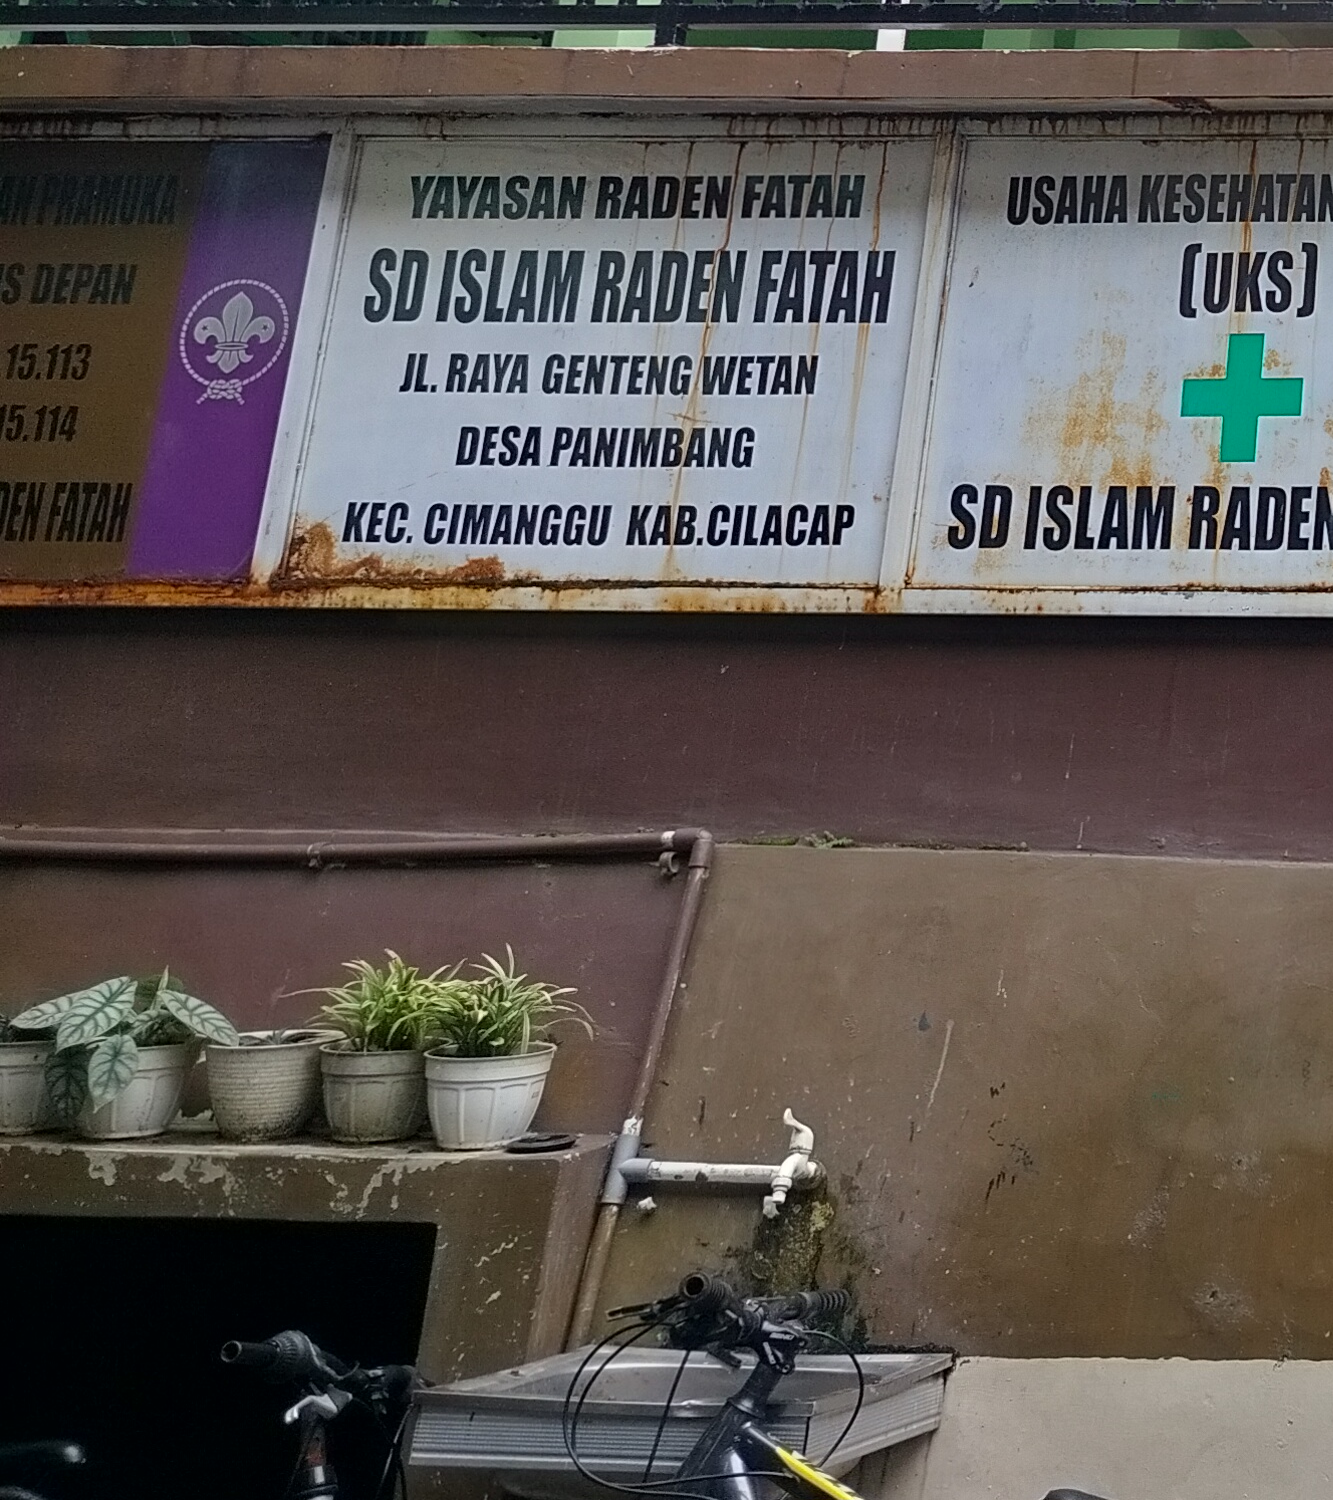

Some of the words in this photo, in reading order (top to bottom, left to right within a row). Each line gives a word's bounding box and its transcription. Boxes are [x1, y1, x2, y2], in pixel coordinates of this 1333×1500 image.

[410, 175, 586, 219] YAYASAN
[595, 176, 730, 219] RADEN
[742, 175, 865, 218] FATAH
[1006, 175, 1128, 224] USAHA
[31, 264, 138, 305] DEPAN
[363, 249, 432, 323] SD
[436, 249, 577, 323] ISLAM
[590, 249, 748, 323] RADEN
[756, 250, 896, 324] FATAH
[1178, 243, 1318, 318] (UKS)
[7, 343, 92, 380] 15.113
[399, 354, 438, 394] JL.
[445, 354, 529, 394] RAYA
[541, 354, 693, 395] GENTENG
[702, 355, 819, 395] WETAN
[456, 426, 543, 467] DESA
[551, 427, 754, 468] PANIMBANG
[45, 482, 133, 542] FATAH
[342, 502, 412, 544] KEC.
[423, 502, 609, 545] CIMANGGU
[947, 484, 1011, 550] SD
[1023, 485, 1175, 551] ISLAM
